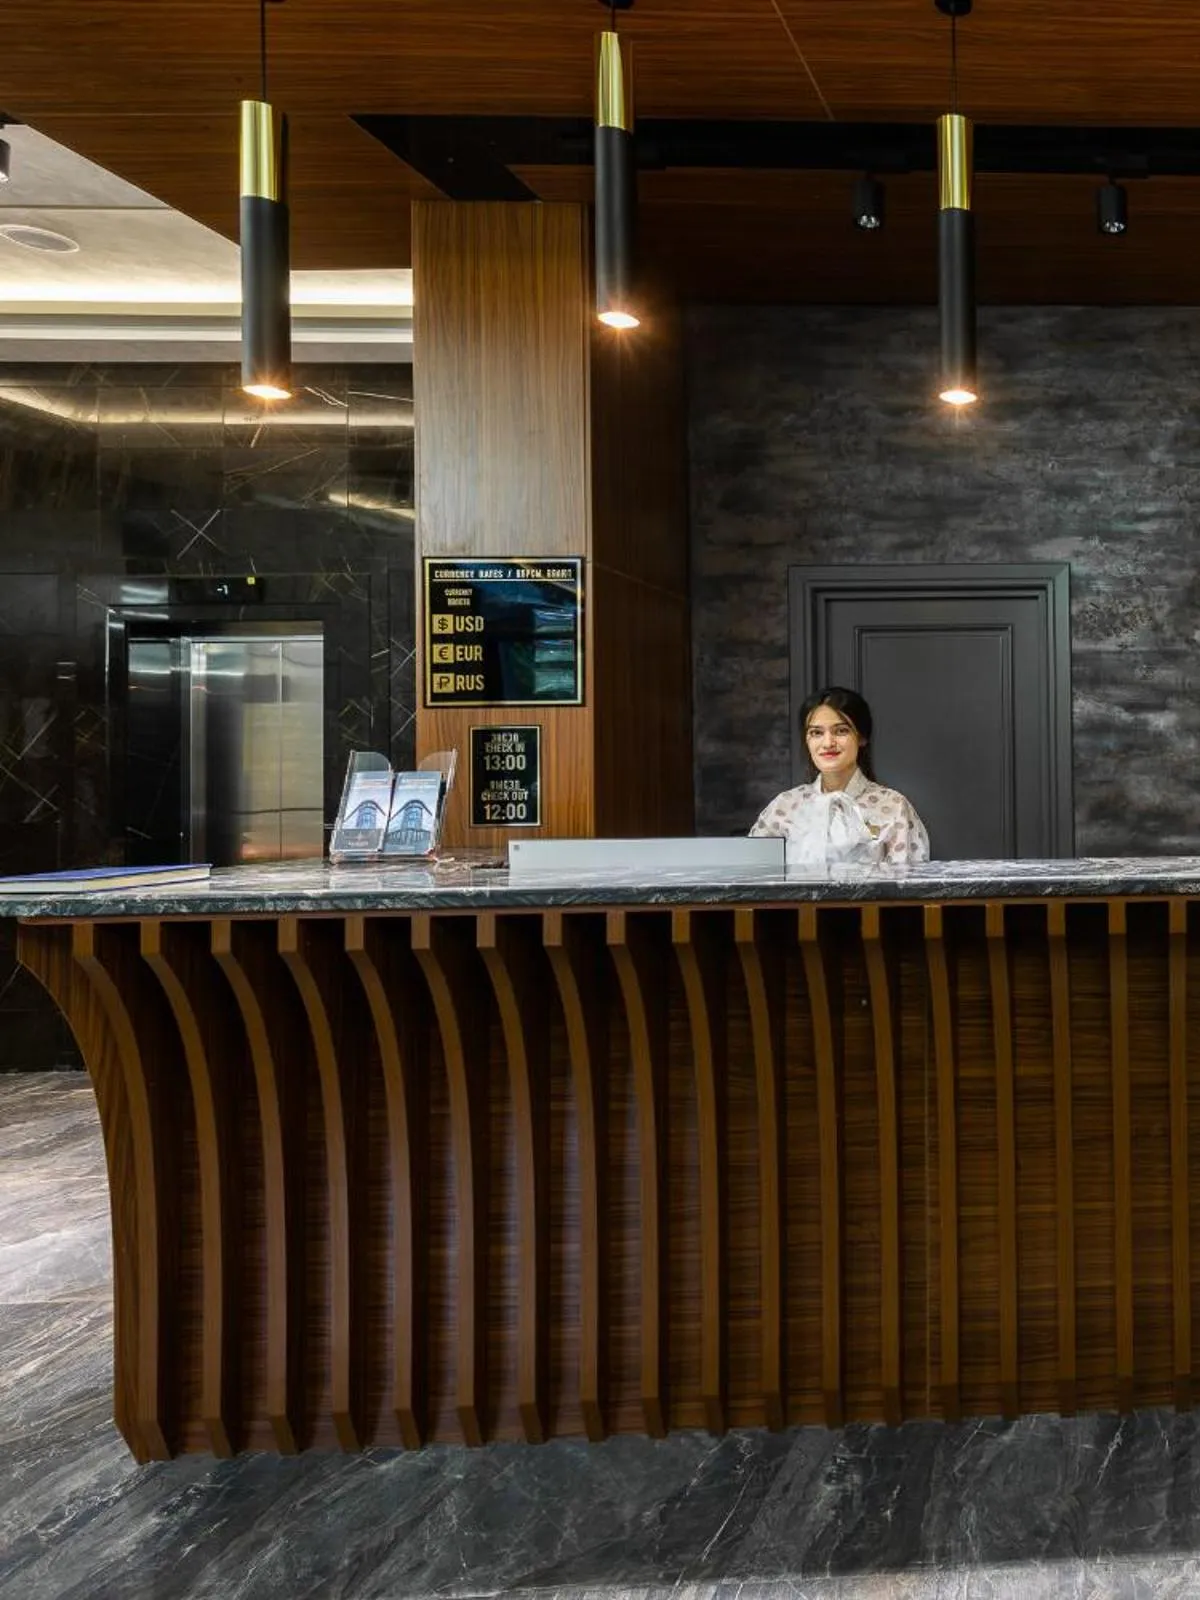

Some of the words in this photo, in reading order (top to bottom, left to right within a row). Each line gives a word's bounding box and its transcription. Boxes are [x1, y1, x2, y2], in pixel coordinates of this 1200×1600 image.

[455, 615, 484, 633] USD
[455, 644, 483, 662] EUR
[456, 674, 485, 691] RUS
[484, 742, 513, 753] CHECK
[515, 742, 526, 753] IN
[484, 754, 526, 771] 13:00
[481, 791, 510, 801] CHECK
[512, 791, 529, 801] OUT
[484, 803, 527, 820] 12:00
